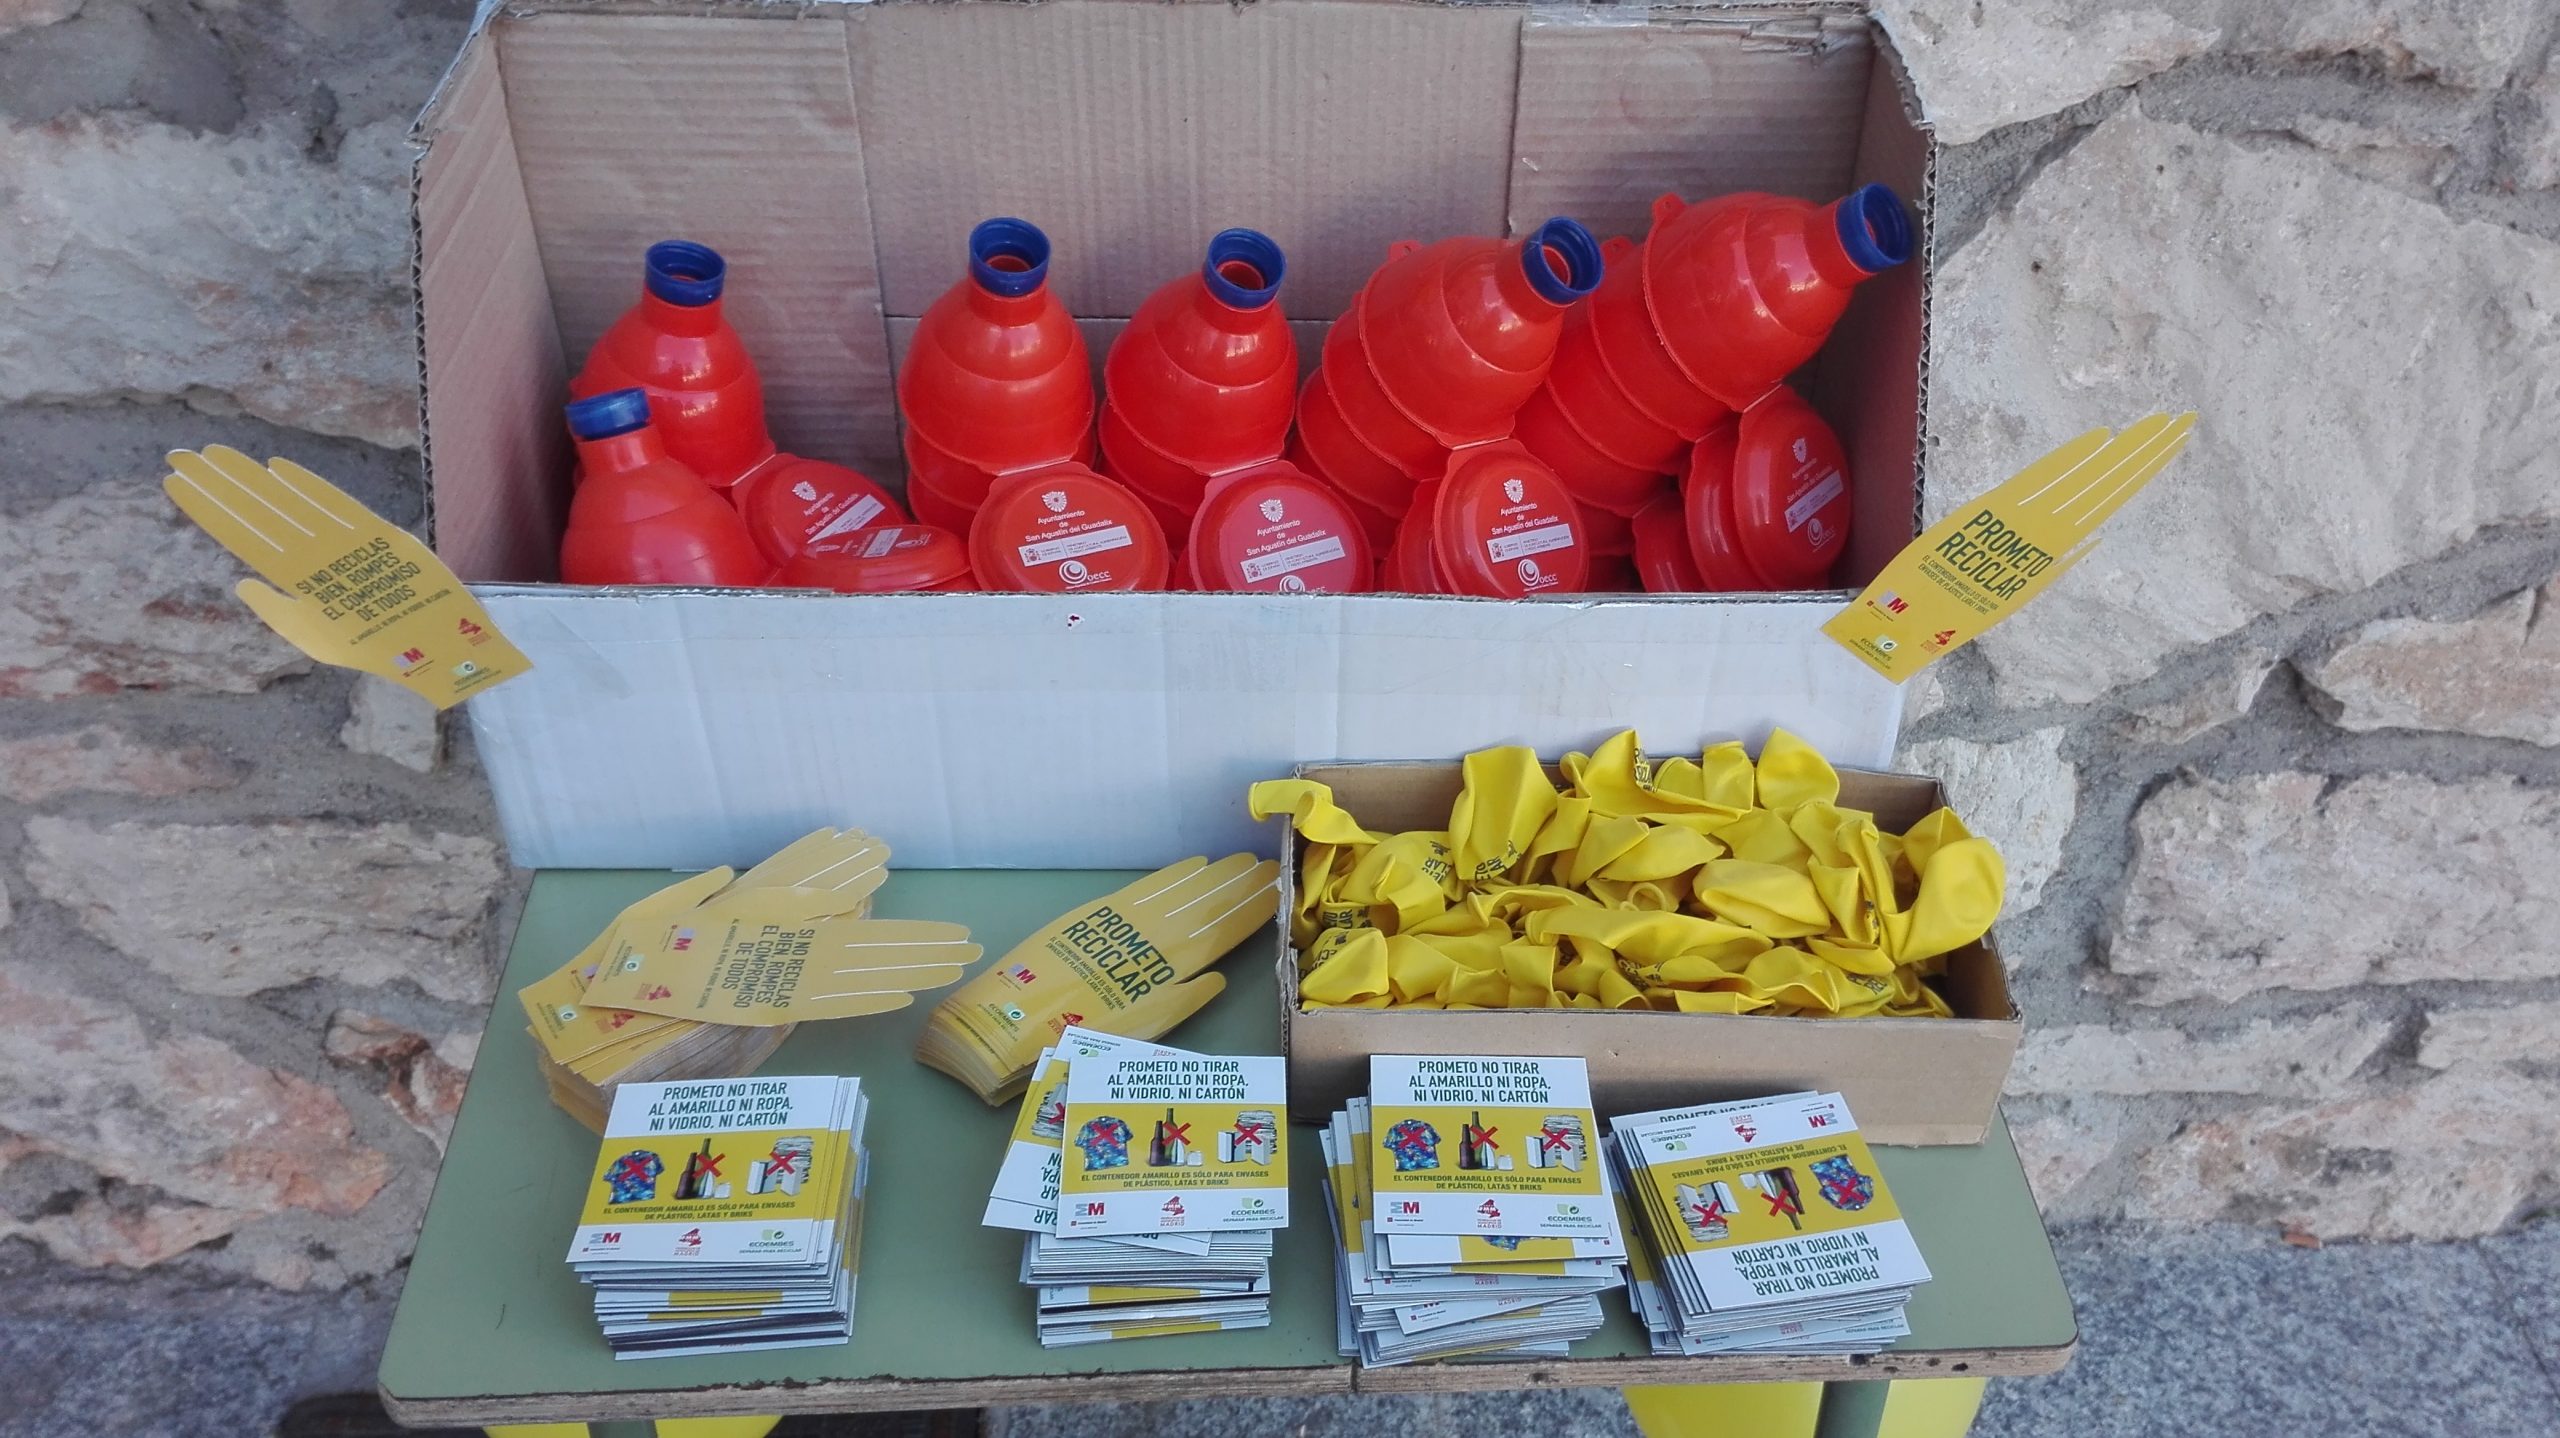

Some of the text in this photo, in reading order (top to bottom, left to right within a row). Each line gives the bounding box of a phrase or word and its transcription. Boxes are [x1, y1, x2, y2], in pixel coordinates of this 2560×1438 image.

[1037, 510, 1085, 525] Ayuntamiento
[1500, 502, 1537, 516] Ayuntamiento
[1516, 513, 1525, 521] de
[1025, 534, 1040, 543] San
[1069, 525, 1081, 534] del
[1081, 519, 1113, 531] Guadalix
[1257, 520, 1301, 536] Ayuntamiento
[1491, 526, 1503, 536] San
[1524, 518, 1534, 528] del
[1533, 515, 1559, 527] Guadalix
[1246, 548, 1261, 556] San
[1286, 536, 1297, 546] del
[1297, 529, 1326, 542] Guadalix
[1962, 509, 2053, 578] PROMETO
[296, 537, 390, 594] SI NO RECICLAS
[346, 552, 400, 587] ROMPES
[1935, 531, 2028, 601] RECICLAR
[322, 604, 345, 620] EL
[340, 562, 421, 610] COMPROMISO
[356, 584, 416, 621] DE TODOS
[1086, 906, 1175, 986] PROMETO
[722, 942, 755, 990] DE TODOS
[733, 925, 779, 1008] EL COMPROMISO
[773, 929, 815, 1008] SI NO RECICLAS
[1061, 920, 1152, 1003] RECICLAR
[755, 961, 786, 1004] ROMPES
[1119, 1061, 1239, 1073] PROMETO NO TIRAR
[1419, 1061, 1540, 1074] PROMETO NO TIRAR
[663, 1082, 787, 1100] PROMETO NO TIRAR
[1107, 1074, 1249, 1087] AL AMARILLO NI ROPA,
[1111, 1085, 1245, 1100] NI VIDRIO, NI CARTÓN
[1409, 1075, 1551, 1089] AL AMARILLO NI ROPA,
[648, 1097, 793, 1116] AL AMARILLO NI ROPA,
[1414, 1088, 1549, 1103] NI VIDRIO, NI CARTÓN
[650, 1110, 788, 1131] NI VIDRIO, NI CARTÓN
[1092, 1173, 1140, 1181] CONTENEDOR
[1235, 1170, 1269, 1178] ENVASES
[1731, 1231, 1870, 1266] NI VIDRIO, NI CARTÓN
[1734, 1247, 1880, 1280] AL AMARILLO NI ROPA,
[1753, 1265, 1880, 1296] PROMETO NO TIRAR
